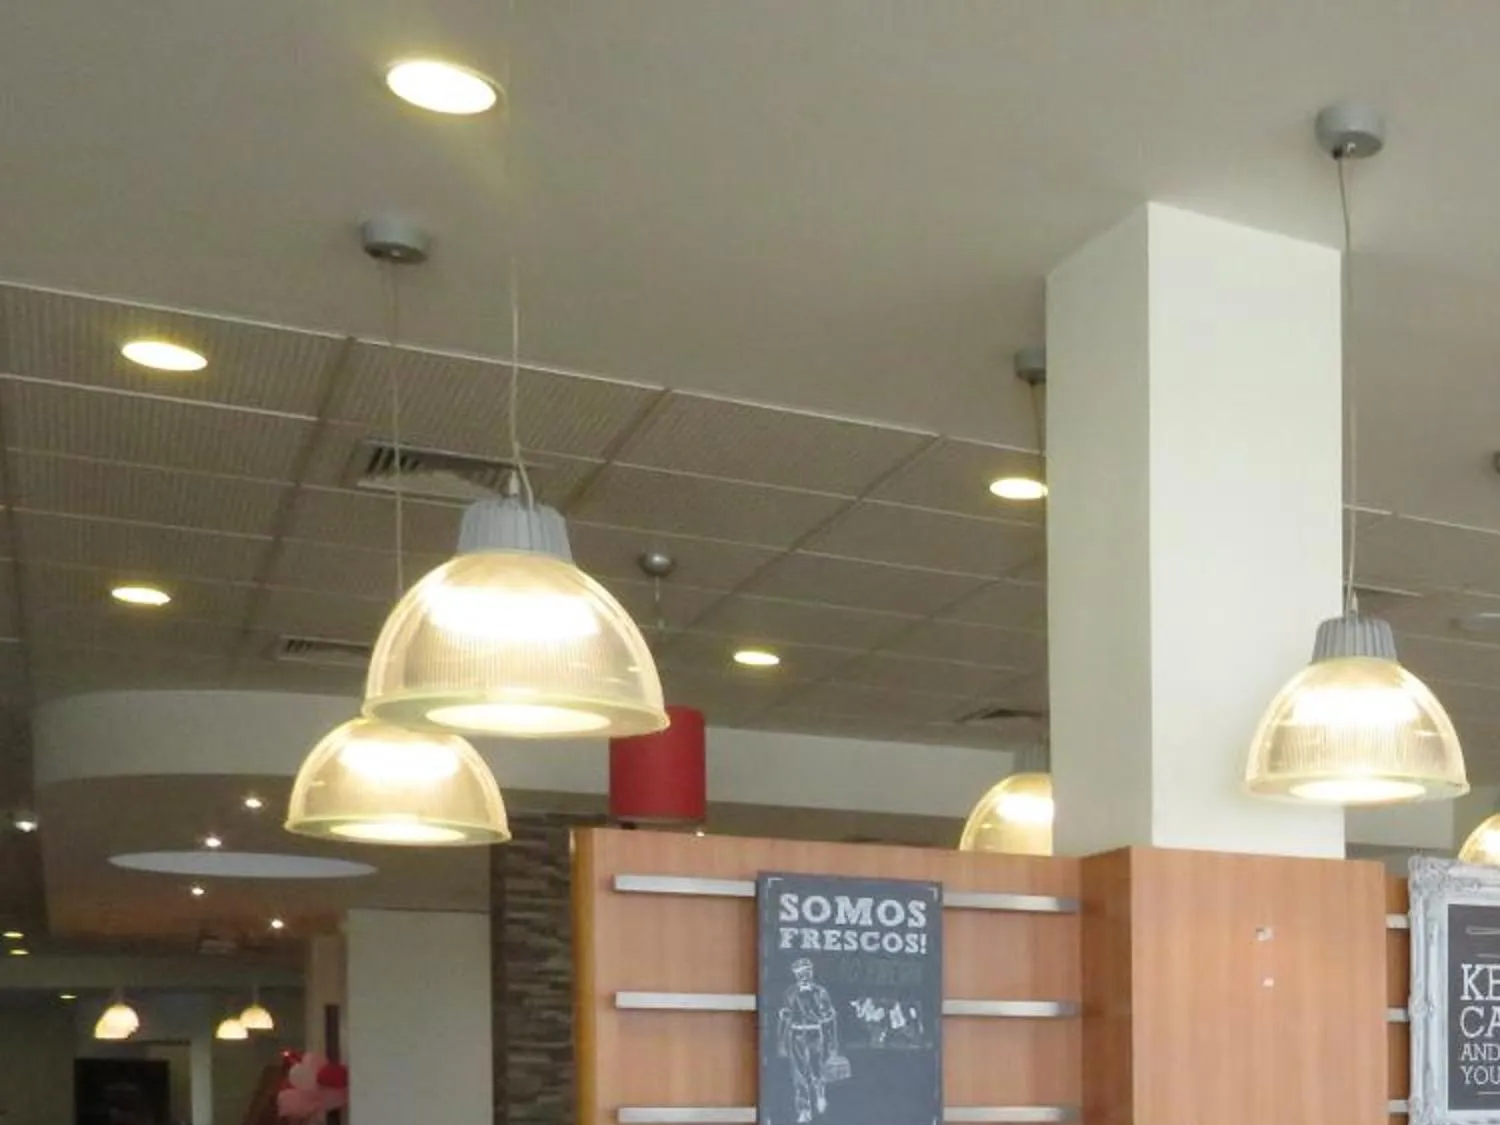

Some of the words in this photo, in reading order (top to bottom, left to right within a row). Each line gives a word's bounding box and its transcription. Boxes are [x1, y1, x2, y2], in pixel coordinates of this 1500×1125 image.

[779, 893, 927, 928] SOMOS
[779, 927, 927, 954] FRESCOS!
[1460, 1043, 1500, 1062] AND
